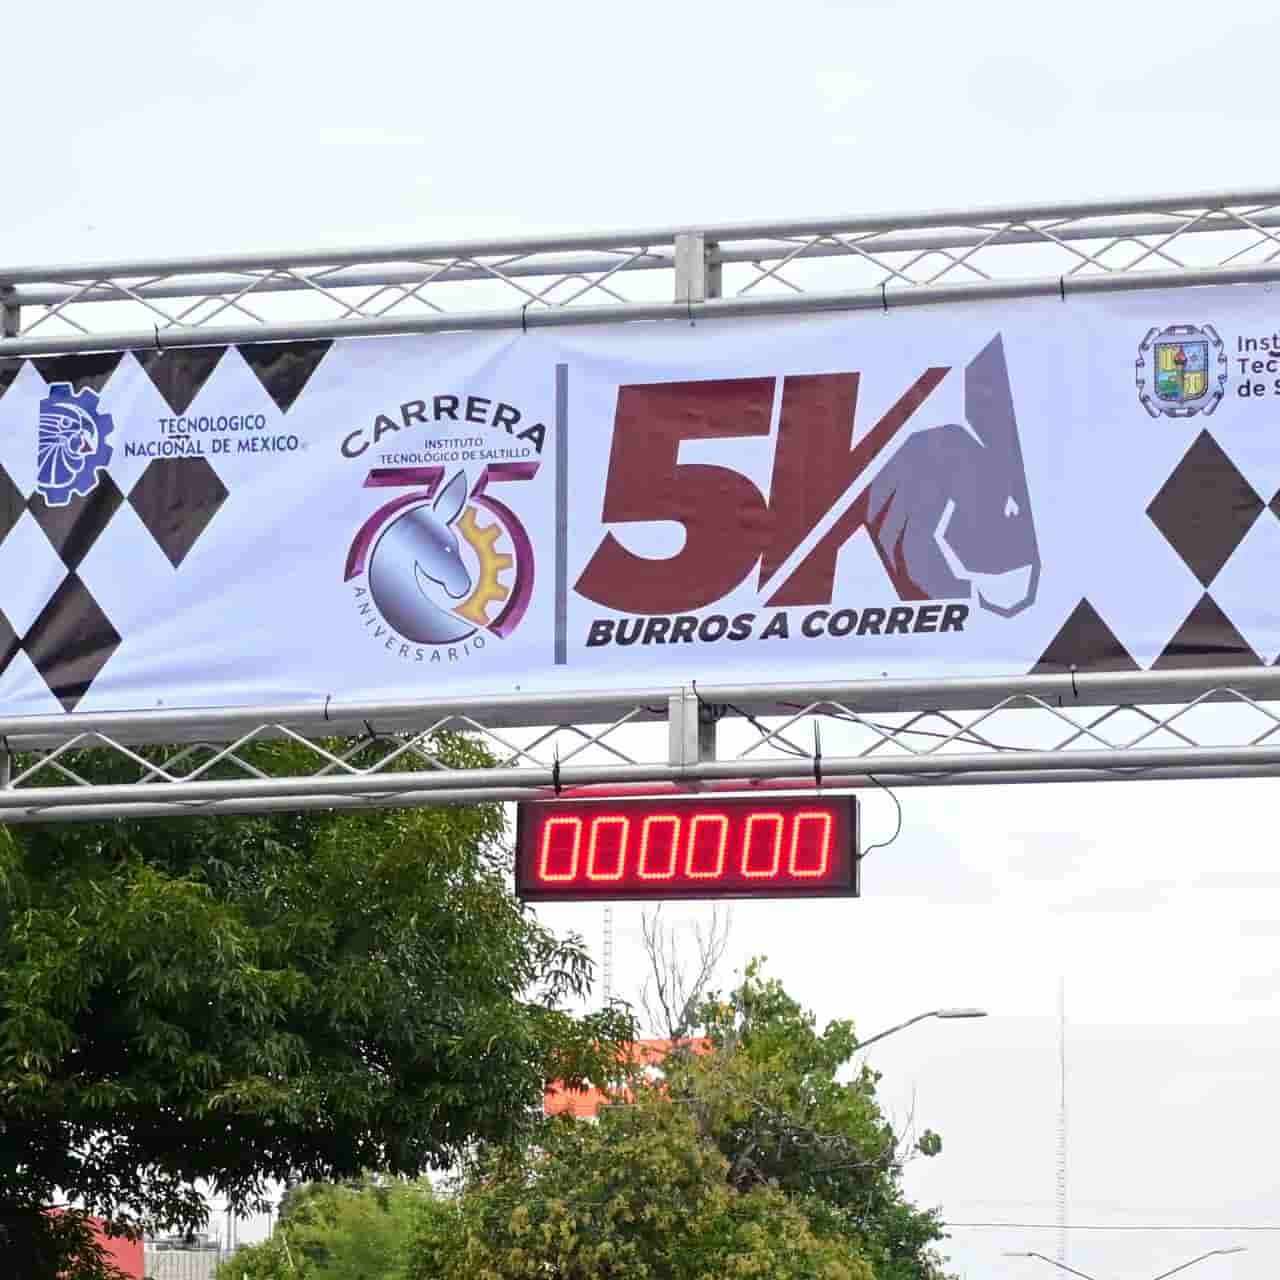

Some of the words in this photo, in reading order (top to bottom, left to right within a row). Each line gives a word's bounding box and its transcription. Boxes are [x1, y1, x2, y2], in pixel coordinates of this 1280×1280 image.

[1237, 380, 1256, 397] de
[159, 415, 266, 434] TECNOLOGICO
[340, 394, 547, 459] CARRERA
[124, 436, 204, 456] NACIONAL
[212, 437, 232, 454] DE
[237, 435, 298, 453] MEXICO
[424, 437, 483, 450] INSTITUTO
[461, 449, 477, 461] DE
[480, 446, 530, 460] SALTILLO
[572, 366, 953, 615] 5K
[353, 586, 487, 663] ANIVERSARIO
[586, 612, 754, 647] BURROS
[760, 613, 789, 640] A
[801, 603, 970, 639] CORRER
